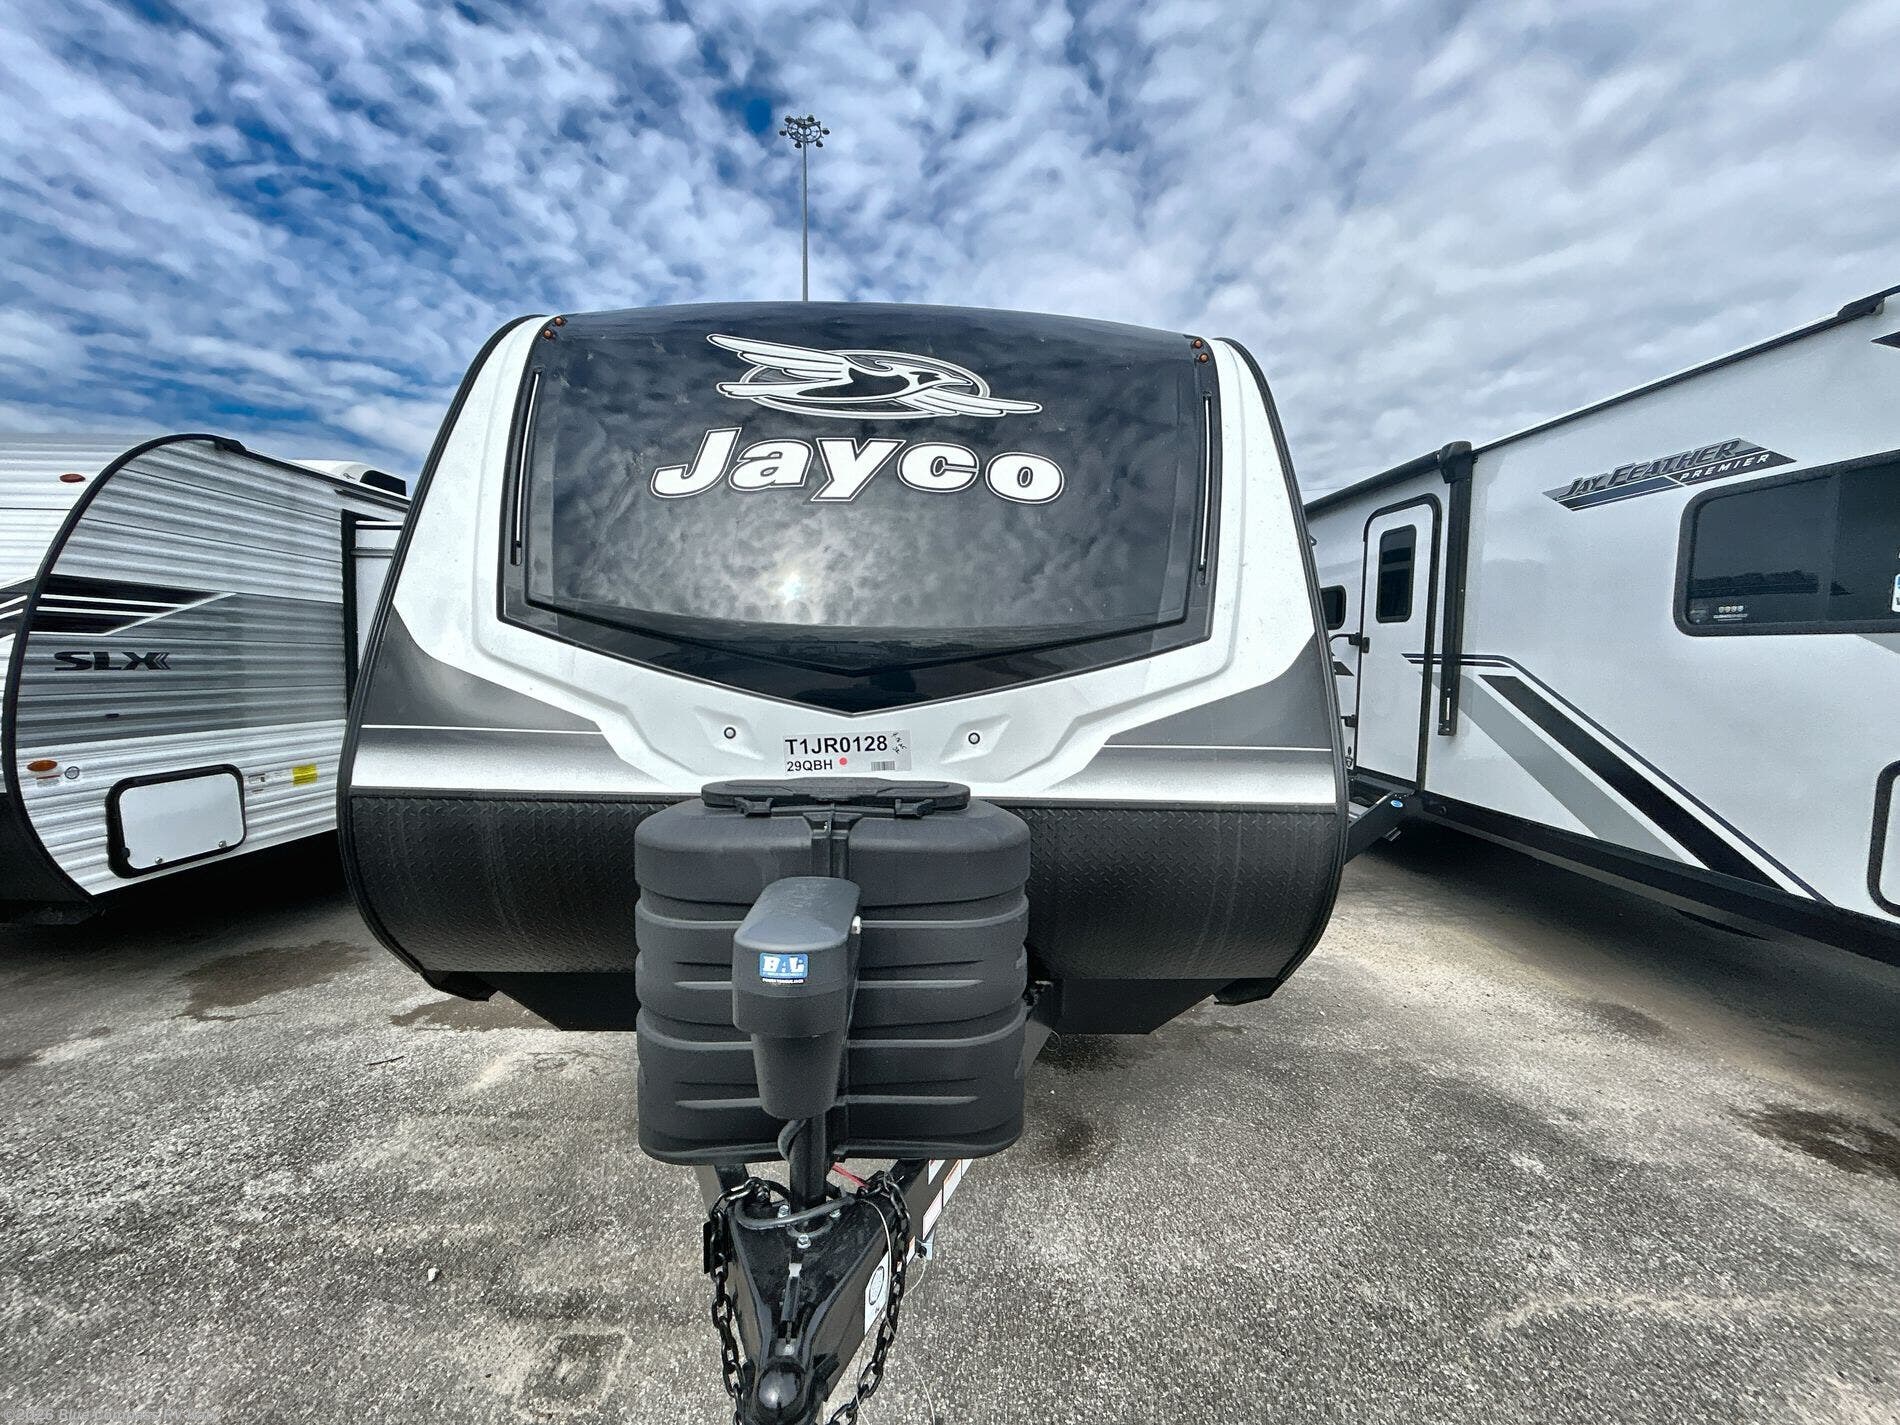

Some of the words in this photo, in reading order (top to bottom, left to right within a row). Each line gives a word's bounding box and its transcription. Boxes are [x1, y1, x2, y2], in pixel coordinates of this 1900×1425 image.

[650, 427, 1064, 504] Jayco
[1679, 453, 1770, 482] PREMIER
[54, 651, 170, 671] SLX
[785, 735, 888, 755] T1JR0128
[787, 759, 833, 772] 29QBH
